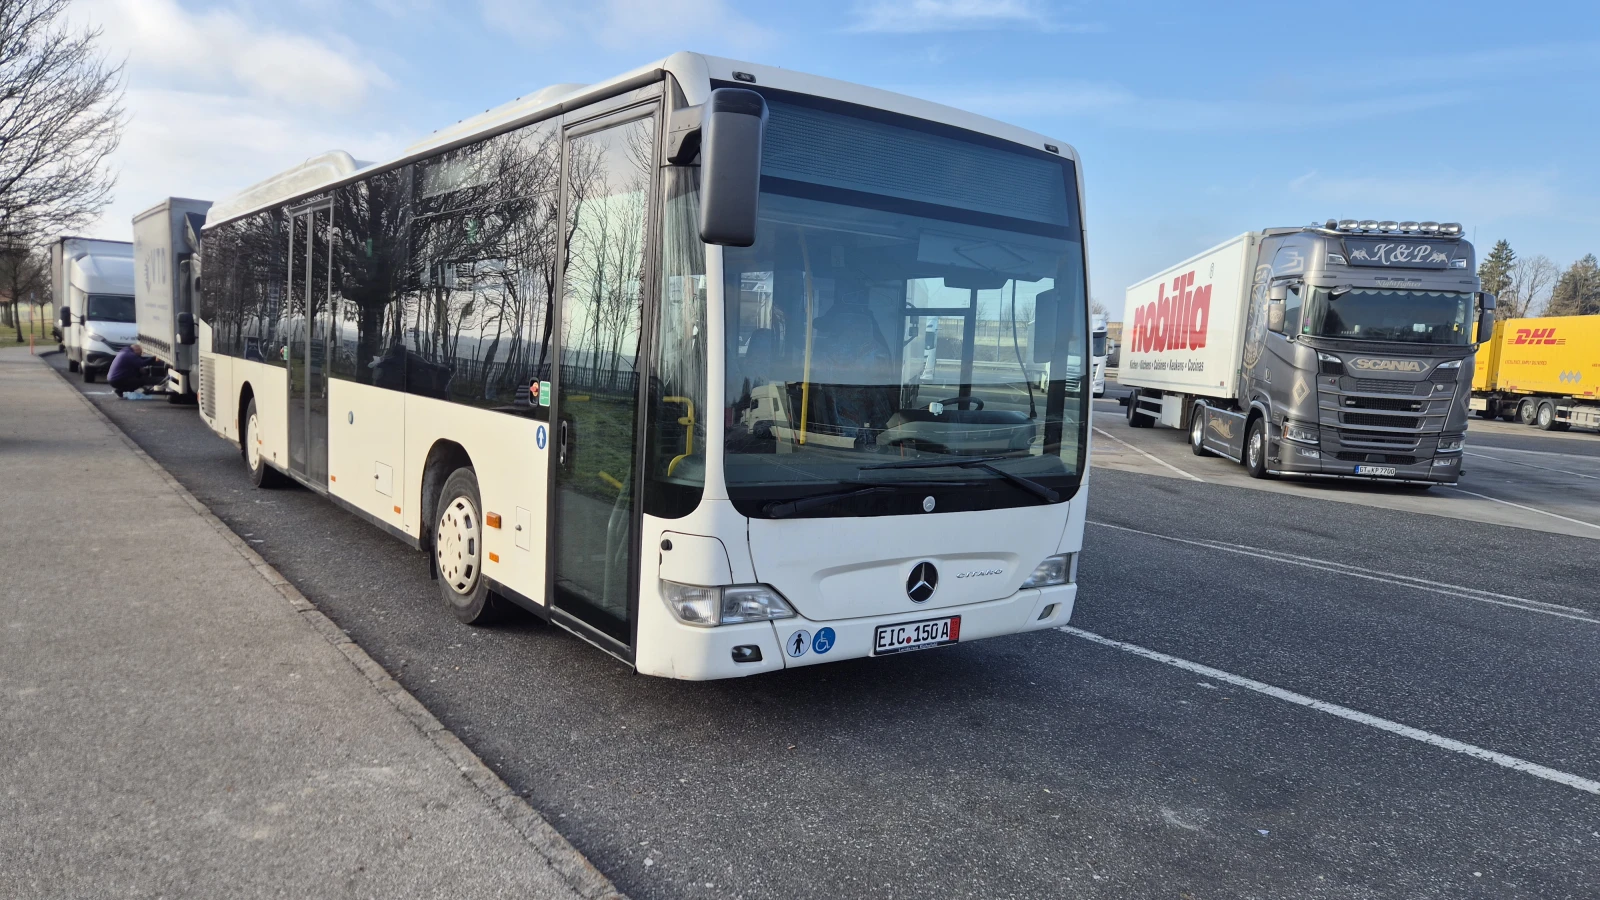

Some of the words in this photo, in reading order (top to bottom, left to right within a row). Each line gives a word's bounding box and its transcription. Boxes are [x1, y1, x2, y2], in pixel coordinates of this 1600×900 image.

[1371, 243, 1432, 265] K&P
[1131, 270, 1212, 354] nobilia
[1514, 328, 1557, 345] DHL
[1356, 359, 1421, 372] SCANIA
[956, 569, 1003, 579] CITARO
[878, 628, 906, 648] EIC
[913, 623, 938, 643] 150
[941, 621, 949, 639] A
